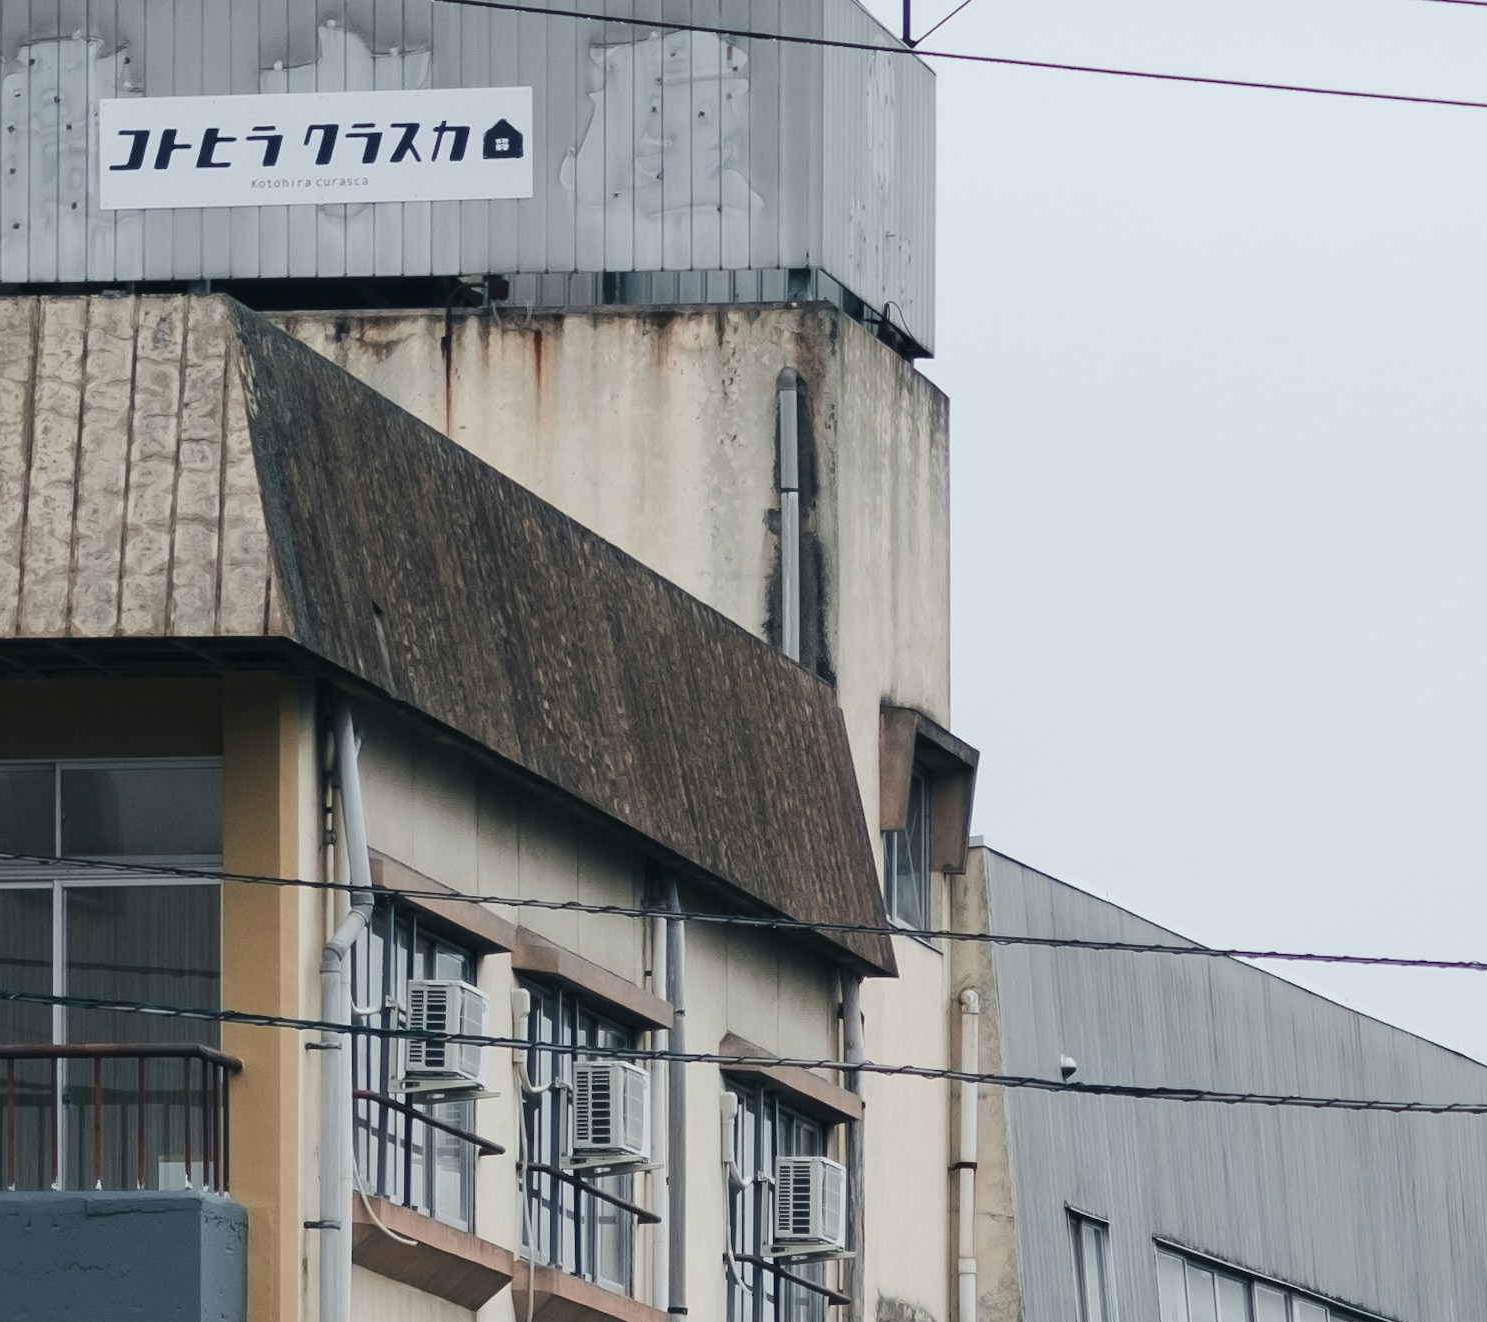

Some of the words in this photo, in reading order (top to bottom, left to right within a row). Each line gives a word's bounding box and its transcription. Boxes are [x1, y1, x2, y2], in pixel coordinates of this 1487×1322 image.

[109, 125, 284, 171] コトヒラ
[303, 120, 471, 166] クラスカ
